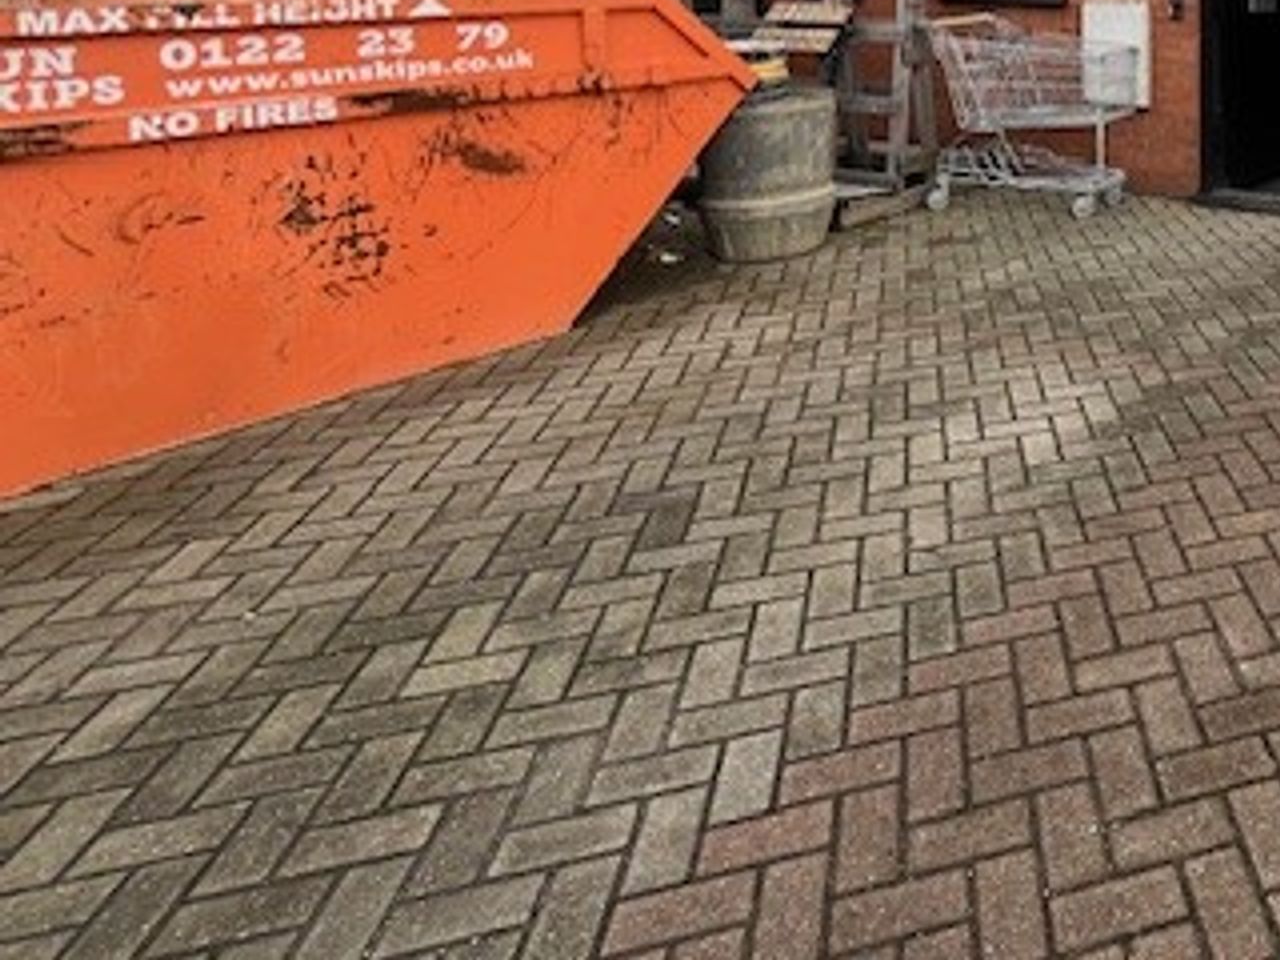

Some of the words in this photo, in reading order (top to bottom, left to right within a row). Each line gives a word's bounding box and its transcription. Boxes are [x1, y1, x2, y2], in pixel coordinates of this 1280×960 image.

[16, 5, 130, 36] MAX
[160, 33, 306, 71] 0122
[356, 26, 415, 58] 23
[455, 20, 510, 50] 79
[164, 48, 534, 98] www.sunskips.co.uk
[128, 110, 200, 142] NO
[214, 96, 338, 133] FIRES
